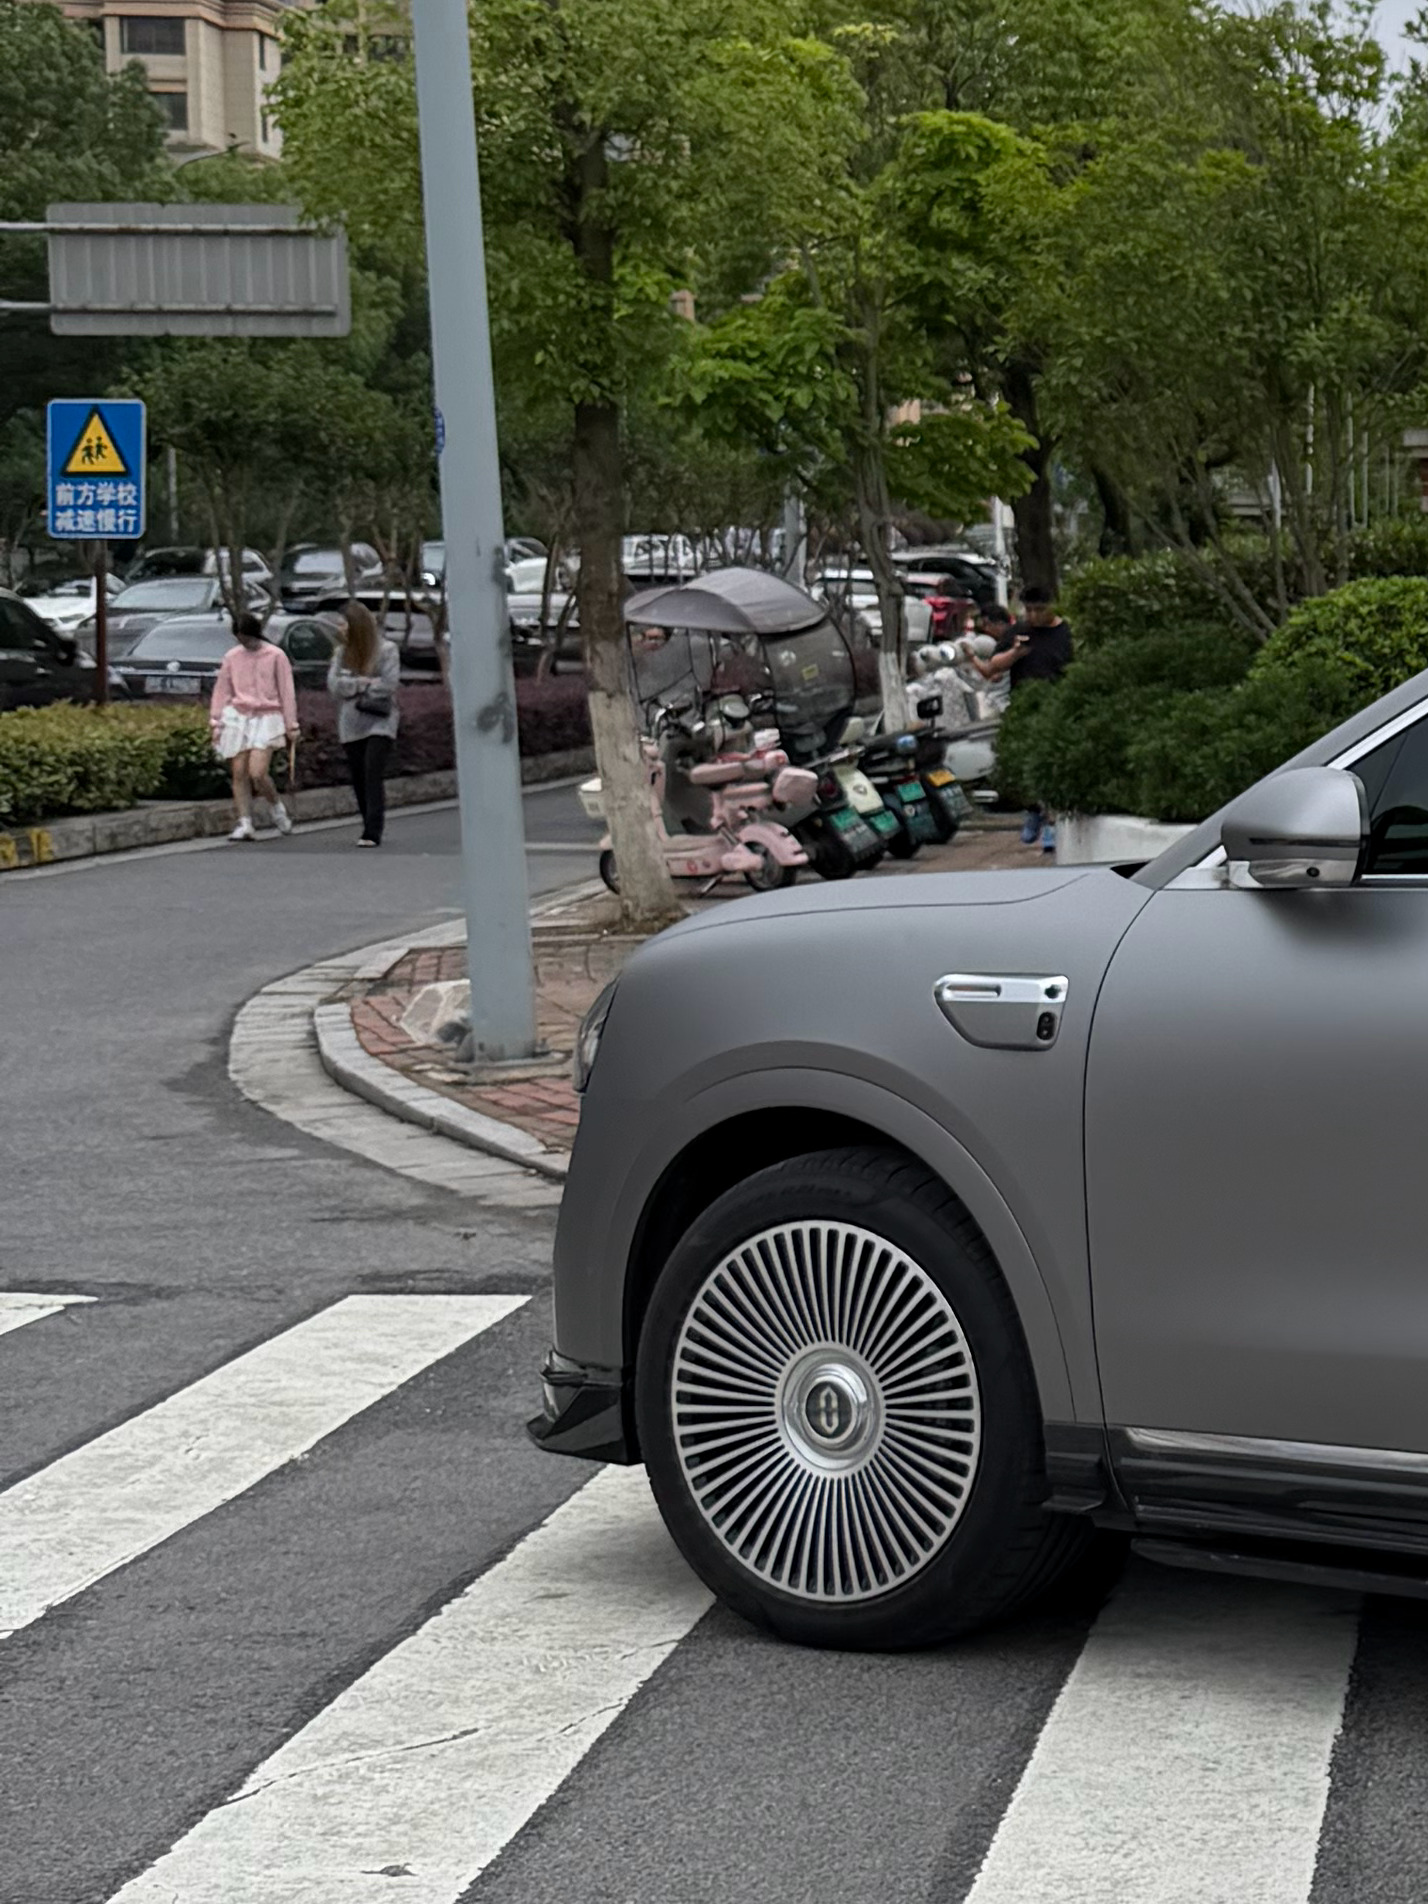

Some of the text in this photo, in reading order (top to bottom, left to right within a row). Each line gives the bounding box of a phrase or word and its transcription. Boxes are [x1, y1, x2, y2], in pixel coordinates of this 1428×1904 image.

[55, 482, 138, 506] 前方学校
[55, 508, 138, 532] 减速慢行
